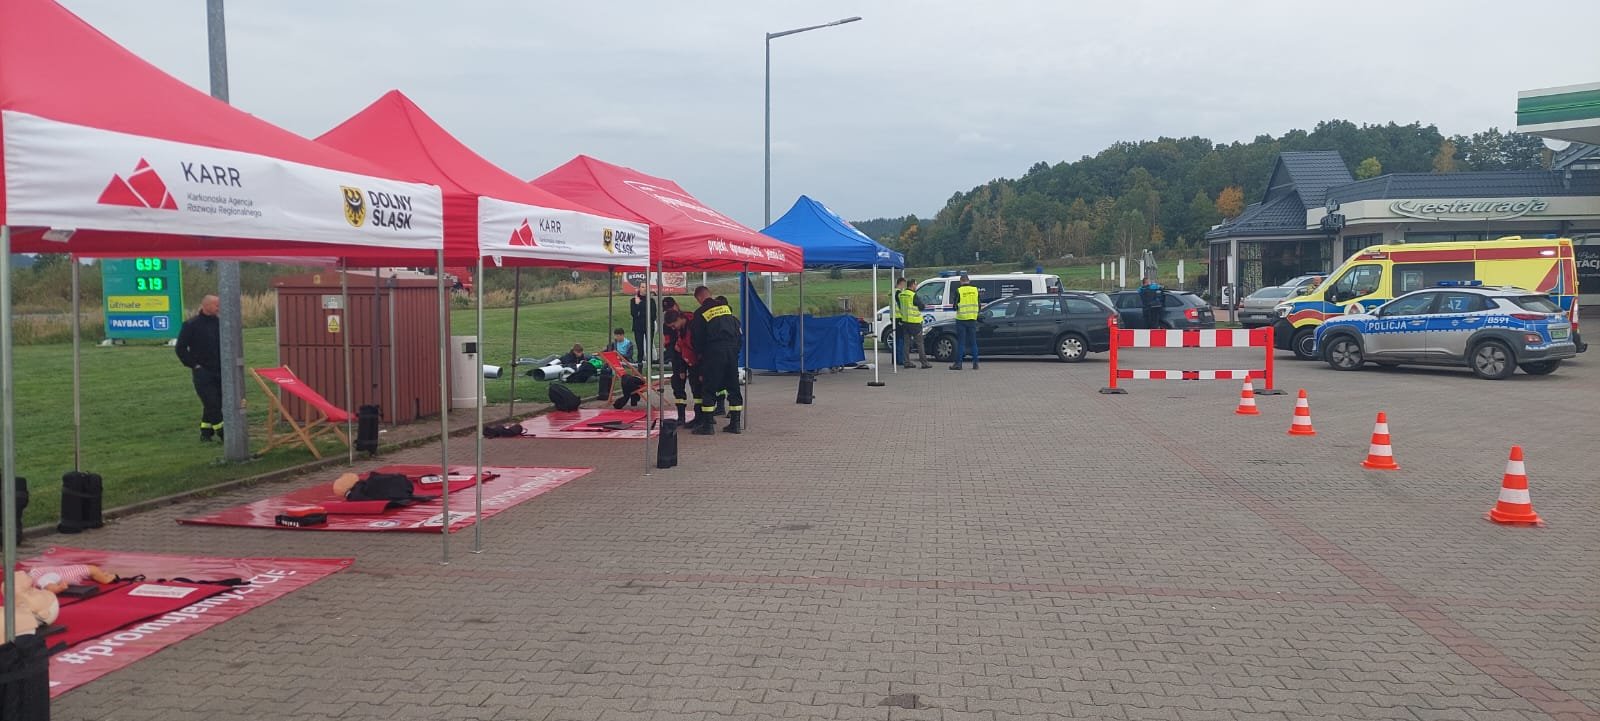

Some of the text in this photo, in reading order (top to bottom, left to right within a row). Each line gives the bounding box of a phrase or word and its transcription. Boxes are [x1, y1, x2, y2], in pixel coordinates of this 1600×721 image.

[181, 161, 242, 188] KARR
[367, 190, 412, 211] DOLNY
[186, 203, 217, 216] Rozwoju
[1399, 199, 1549, 216] restauracja
[372, 205, 413, 231] ŚLĄSK
[540, 218, 562, 233] KARR
[615, 230, 636, 244] DOLNY
[1576, 260, 1600, 270] TACJ
[137, 277, 163, 290] 3.19
[112, 319, 151, 328] PAYBACK
[1368, 321, 1407, 331] POLICJA
[1487, 316, 1510, 324] B591
